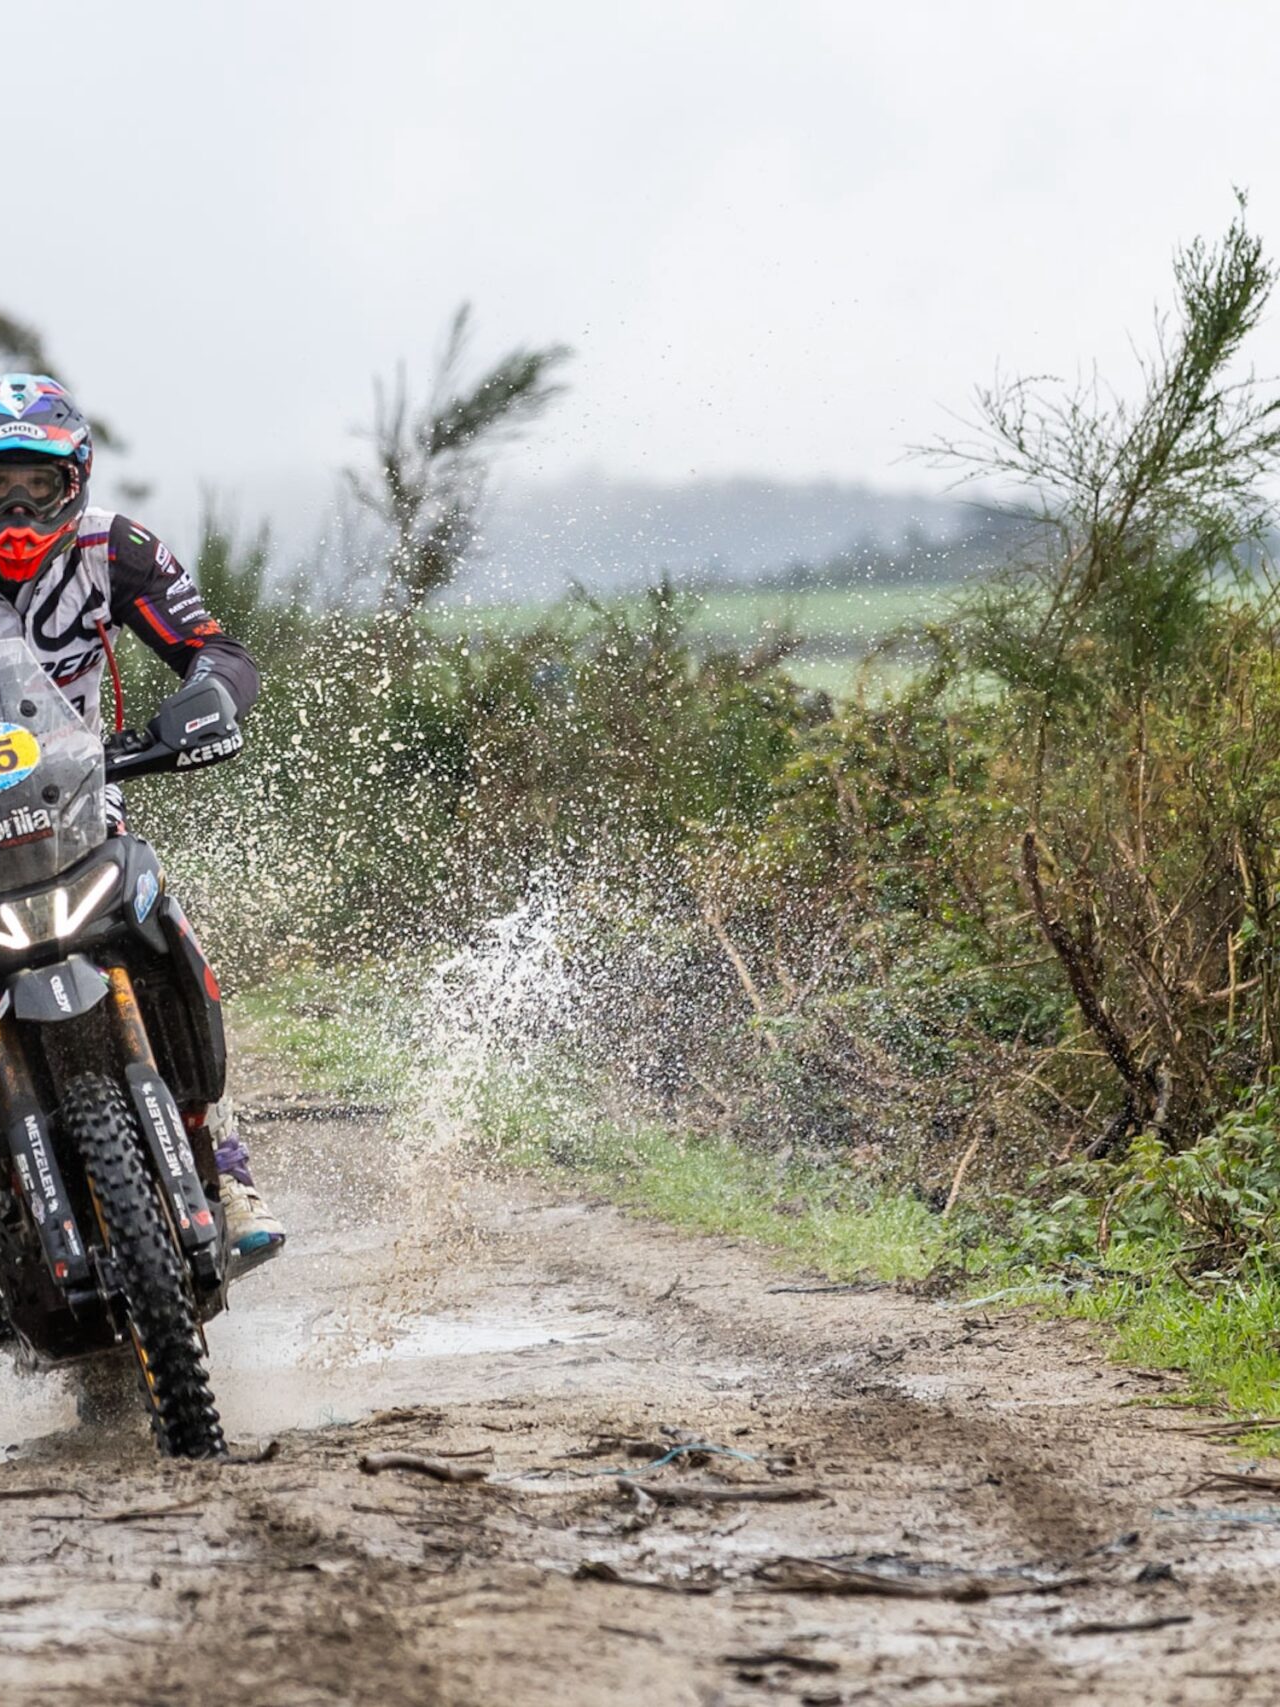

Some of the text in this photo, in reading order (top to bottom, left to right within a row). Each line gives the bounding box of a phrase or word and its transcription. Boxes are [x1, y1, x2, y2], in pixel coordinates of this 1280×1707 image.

[1, 425, 39, 436] SHOEI
[23, 1114, 57, 1199] METZELER
[145, 1096, 183, 1178] METZELER
